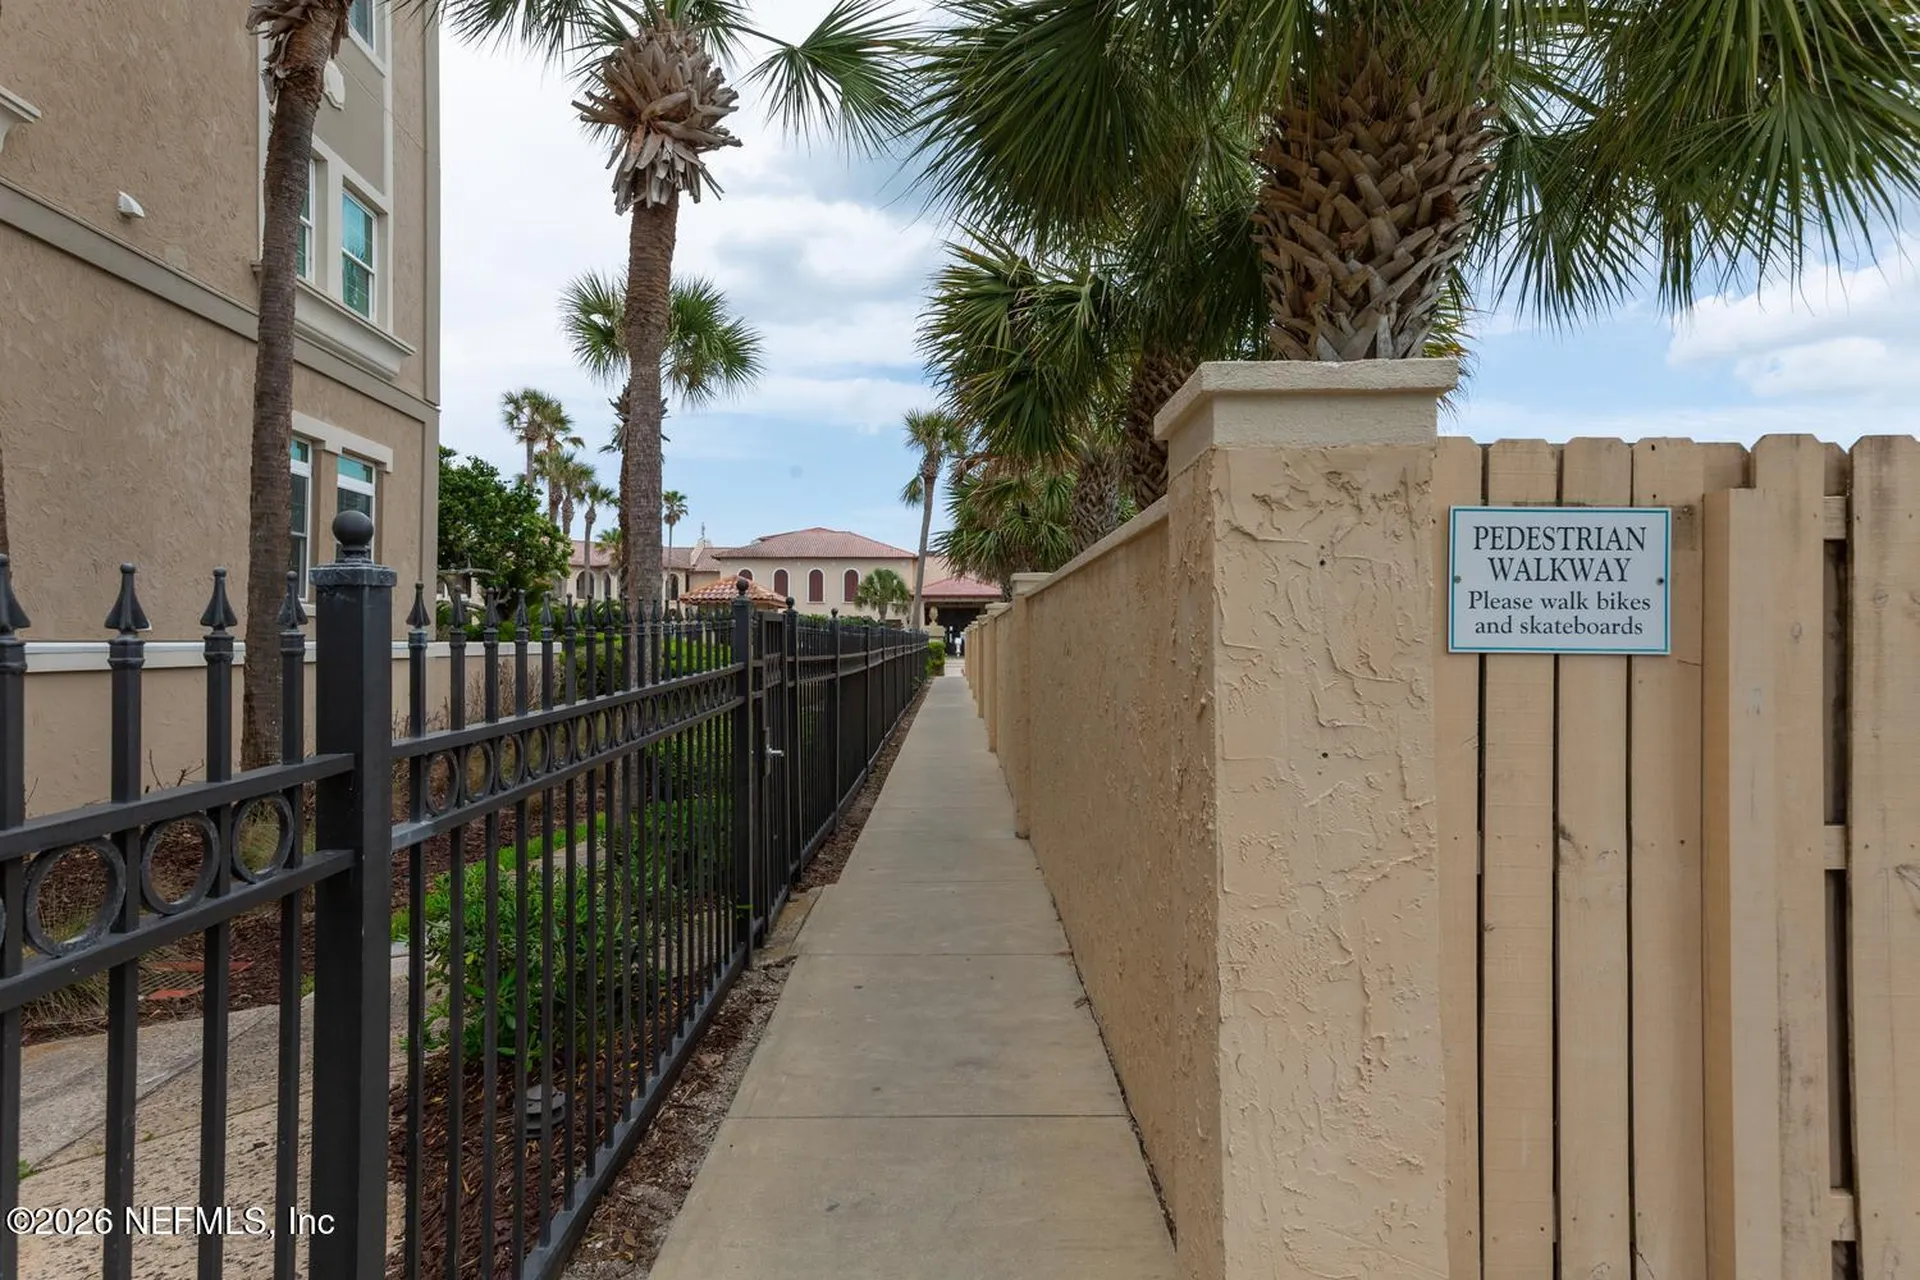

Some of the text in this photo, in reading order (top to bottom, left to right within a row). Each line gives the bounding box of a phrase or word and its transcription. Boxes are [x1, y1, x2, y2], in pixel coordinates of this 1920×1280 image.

[1473, 525, 1647, 551] PEDESTRIAN
[1486, 556, 1632, 583] WALKWAY
[1467, 590, 1651, 610] Please walk bikes
[1474, 614, 1643, 635] and skateboards
